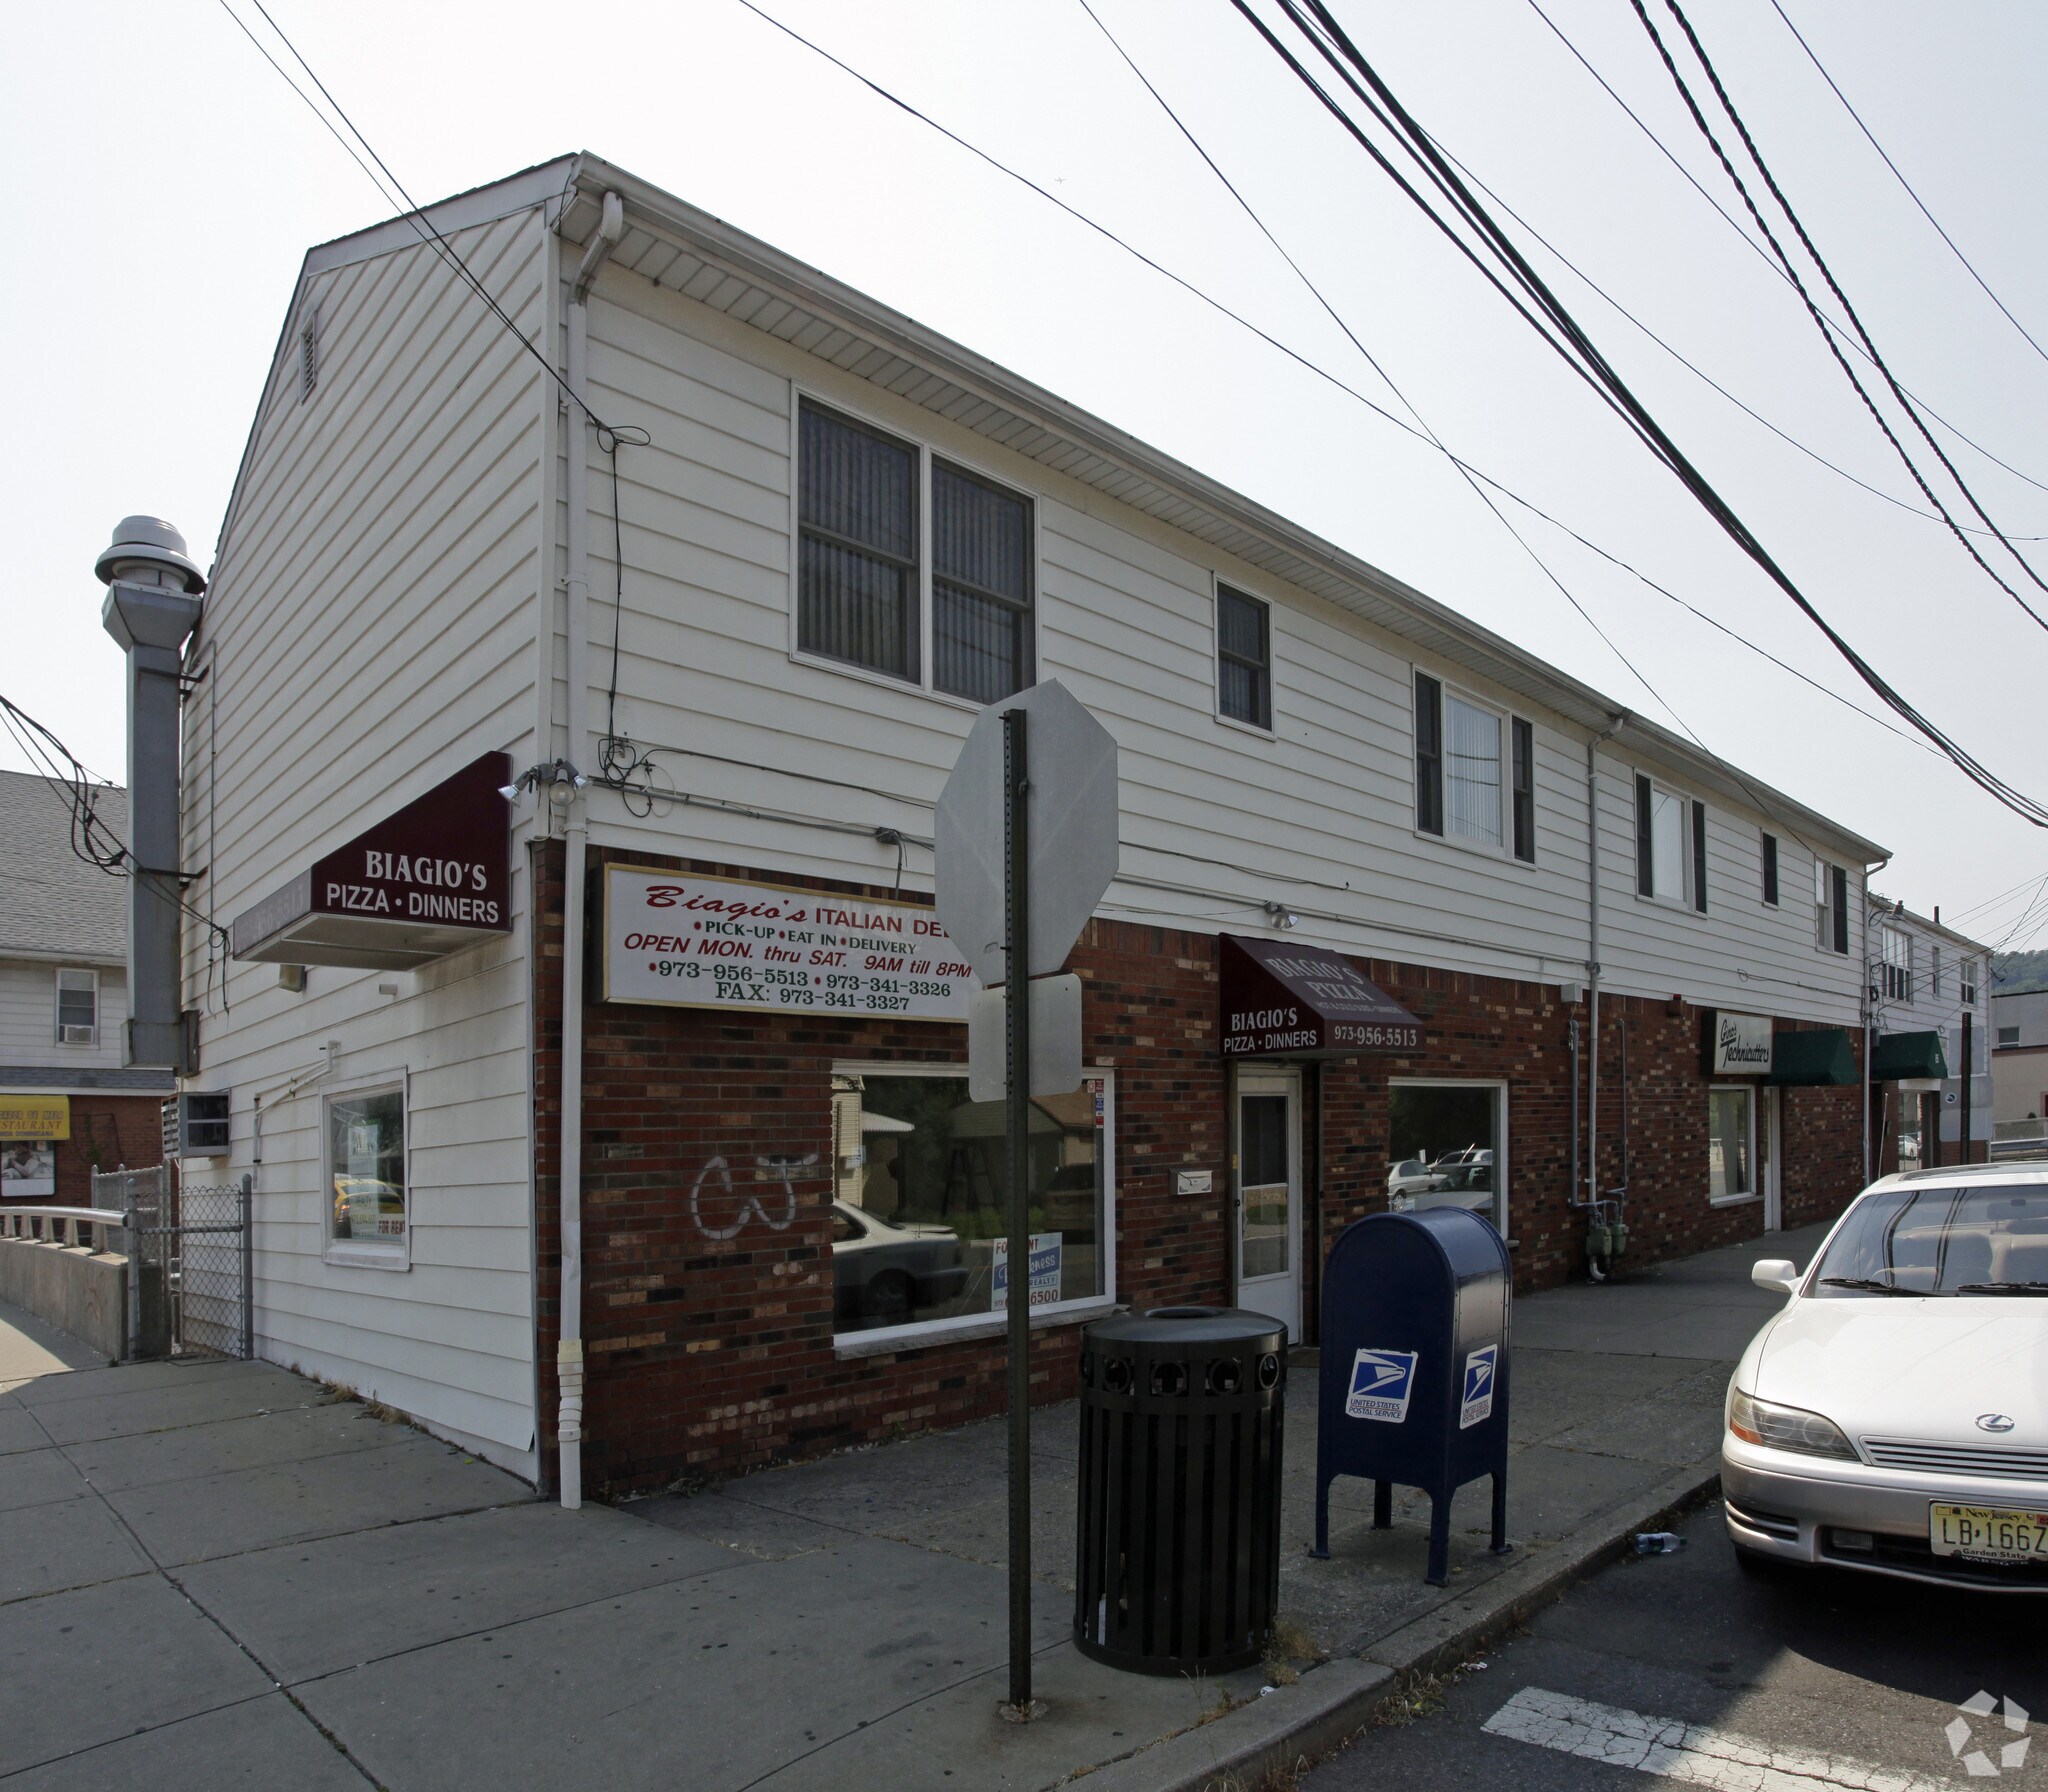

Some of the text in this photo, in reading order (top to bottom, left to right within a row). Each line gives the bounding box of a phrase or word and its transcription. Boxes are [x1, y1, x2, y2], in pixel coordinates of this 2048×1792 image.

[365, 850, 487, 891] BIAGIO'S
[326, 883, 499, 924] PIZZA DINNERS
[645, 885, 807, 923] Biagio's
[815, 908, 903, 933] ITALIAN
[705, 921, 917, 955] PICK-UP EAT IN DELIVERY
[623, 932, 973, 978] OPEN MON. thru SAT. 9AM till 8PM
[658, 960, 951, 997] 973-956-5513 973-341-3326
[1265, 958, 1364, 985] BIAGIO'S
[715, 981, 910, 1011] FAX: 973-341-3327
[1304, 981, 1375, 1001] PIZZA
[1231, 1007, 1298, 1032] BIAGIO'S
[1224, 1030, 1317, 1053] PIZZA DINNERS
[0, 1120, 62, 1130] STAURANT
[995, 1241, 1008, 1254] FO
[1349, 1407, 1402, 1419] POSTAL SERVICE
[1350, 1399, 1400, 1410] UNITED STATES
[1965, 1508, 2021, 1521] New Jersey
[1962, 1548, 2026, 1560] Garden State
